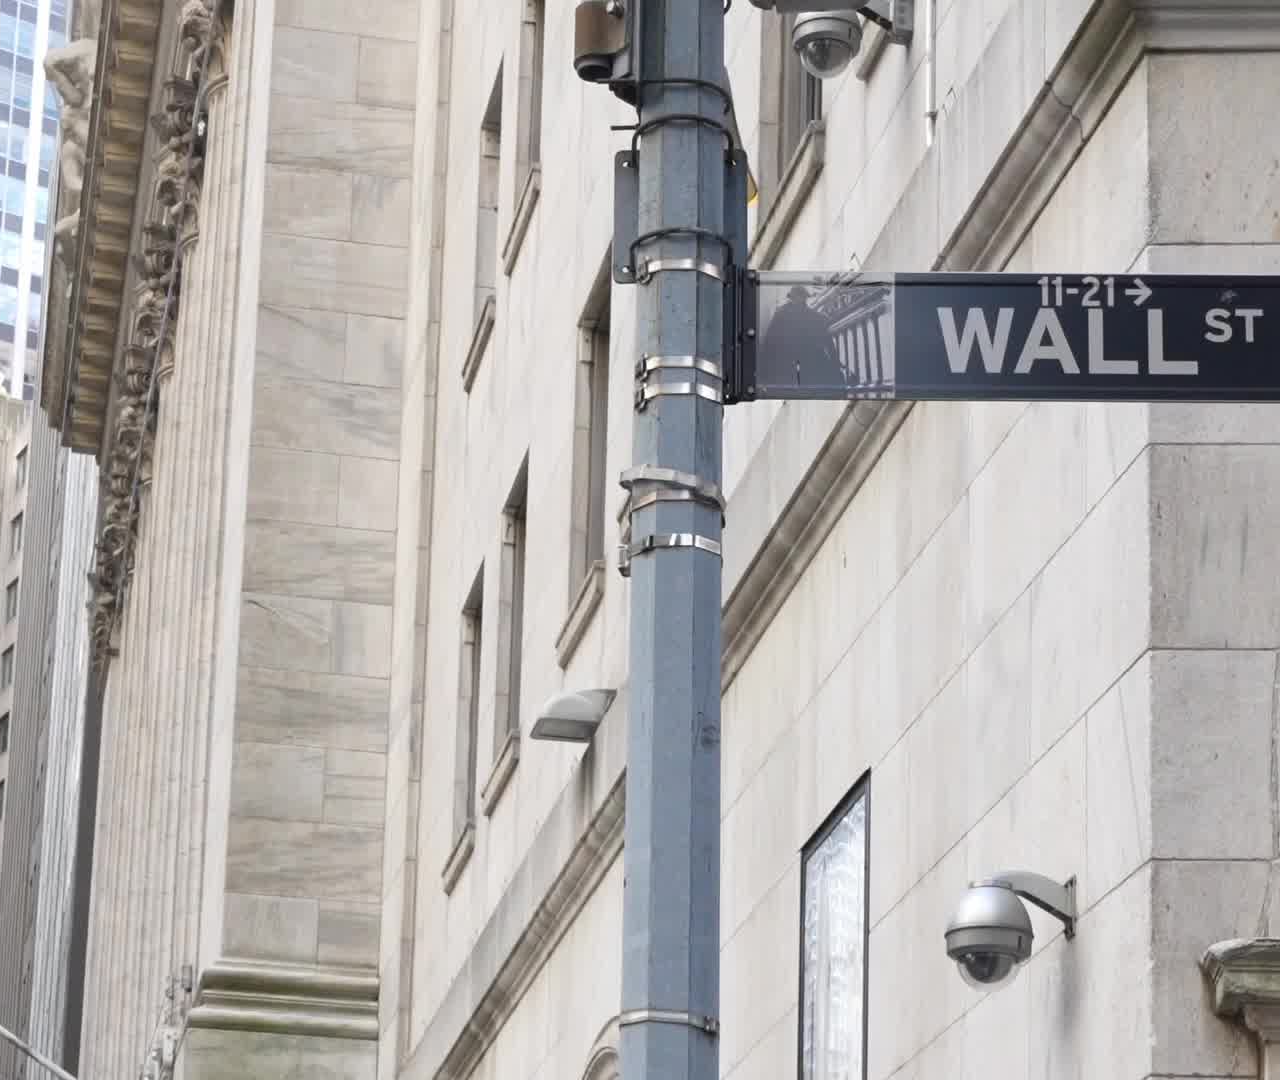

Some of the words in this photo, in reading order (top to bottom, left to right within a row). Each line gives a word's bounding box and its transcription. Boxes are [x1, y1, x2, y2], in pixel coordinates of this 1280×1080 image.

[1037, 276, 1115, 307] 11-21
[936, 306, 1199, 375] WALL
[1205, 308, 1264, 343] ST
